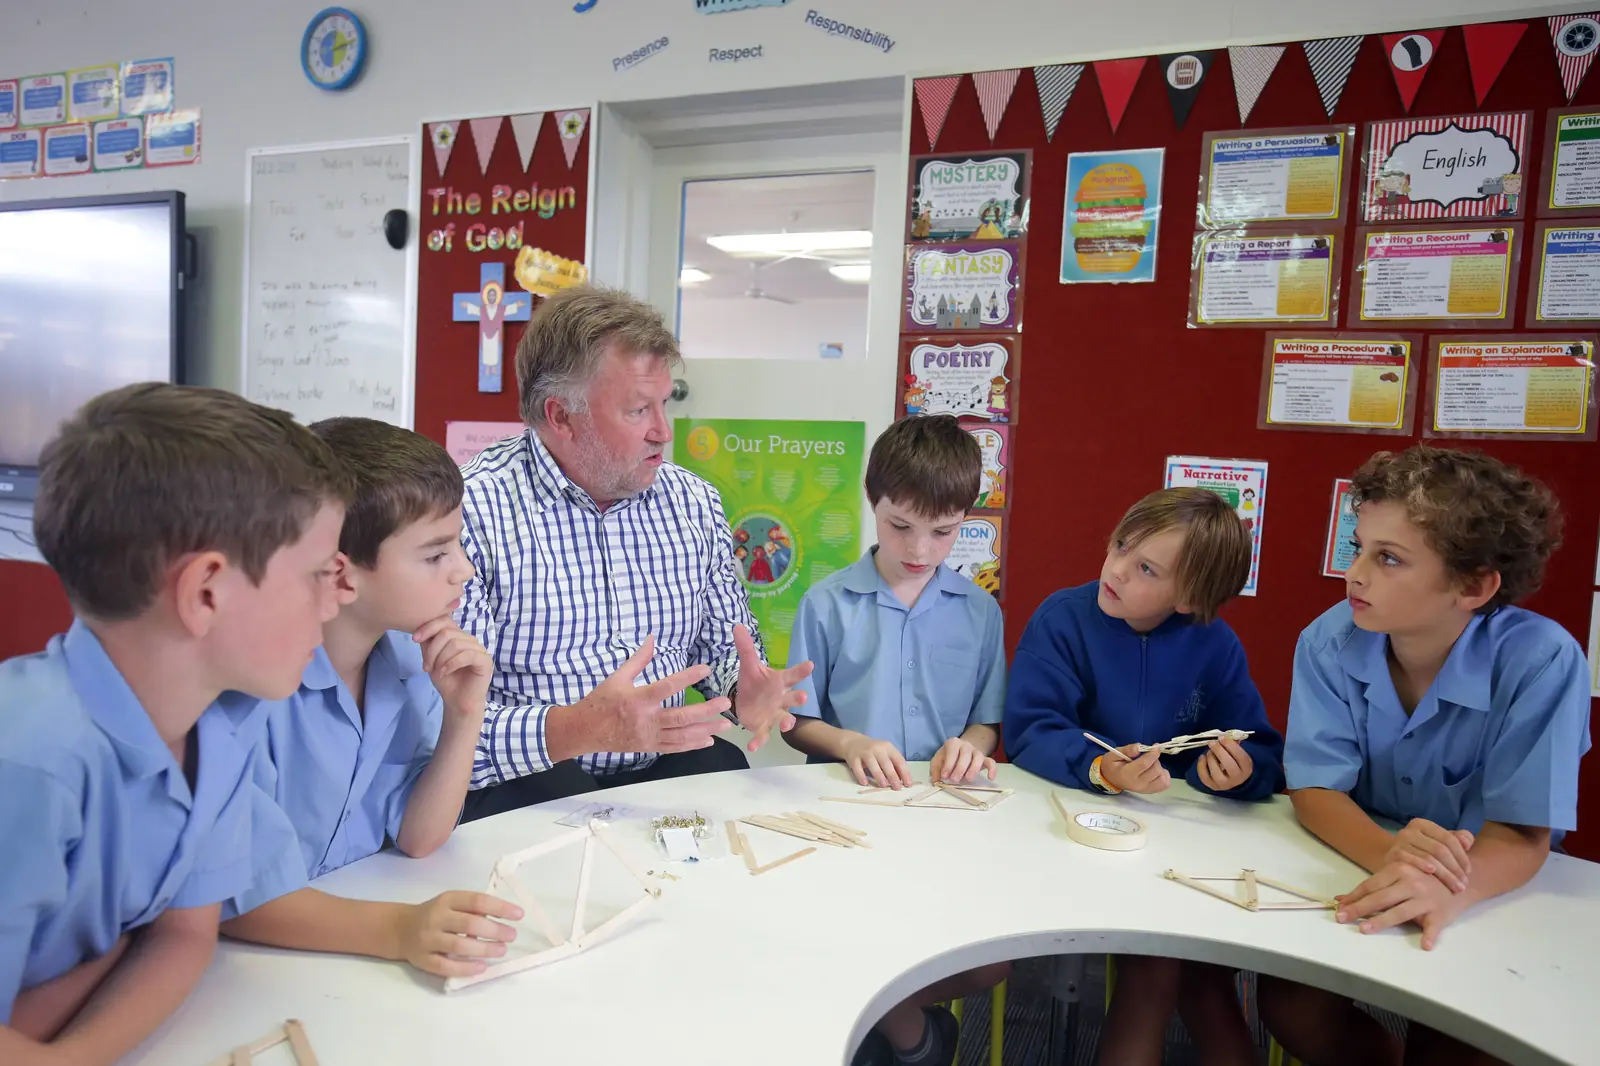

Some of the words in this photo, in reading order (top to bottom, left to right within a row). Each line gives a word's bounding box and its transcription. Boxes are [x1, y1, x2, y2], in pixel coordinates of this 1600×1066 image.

[804, 9, 896, 53] Responsibility
[612, 35, 669, 72] Presence
[709, 44, 763, 63] Respect
[1216, 140, 1253, 150] Writing
[1263, 136, 1320, 147] Persuasion
[1422, 147, 1487, 177] English
[929, 164, 1009, 185] MYSTERY
[427, 187, 482, 216] The
[491, 182, 576, 219] Reign
[427, 222, 456, 252] of
[465, 220, 525, 252] God
[1211, 239, 1245, 249] Witing
[1257, 240, 1291, 249] Report
[1426, 233, 1470, 242] Recount
[1551, 231, 1594, 241] Writing
[920, 255, 1004, 276] FANTASY
[1281, 344, 1319, 353] Writing
[1331, 344, 1385, 353] Procedure
[1445, 346, 1483, 355] Writing
[1501, 346, 1563, 355] Explanation
[923, 350, 994, 368] POETRY
[697, 435, 709, 456] 5
[724, 434, 762, 453] Our
[768, 435, 846, 459] Prayers
[1183, 469, 1249, 482] Narrative
[1197, 480, 1237, 488] Introduction
